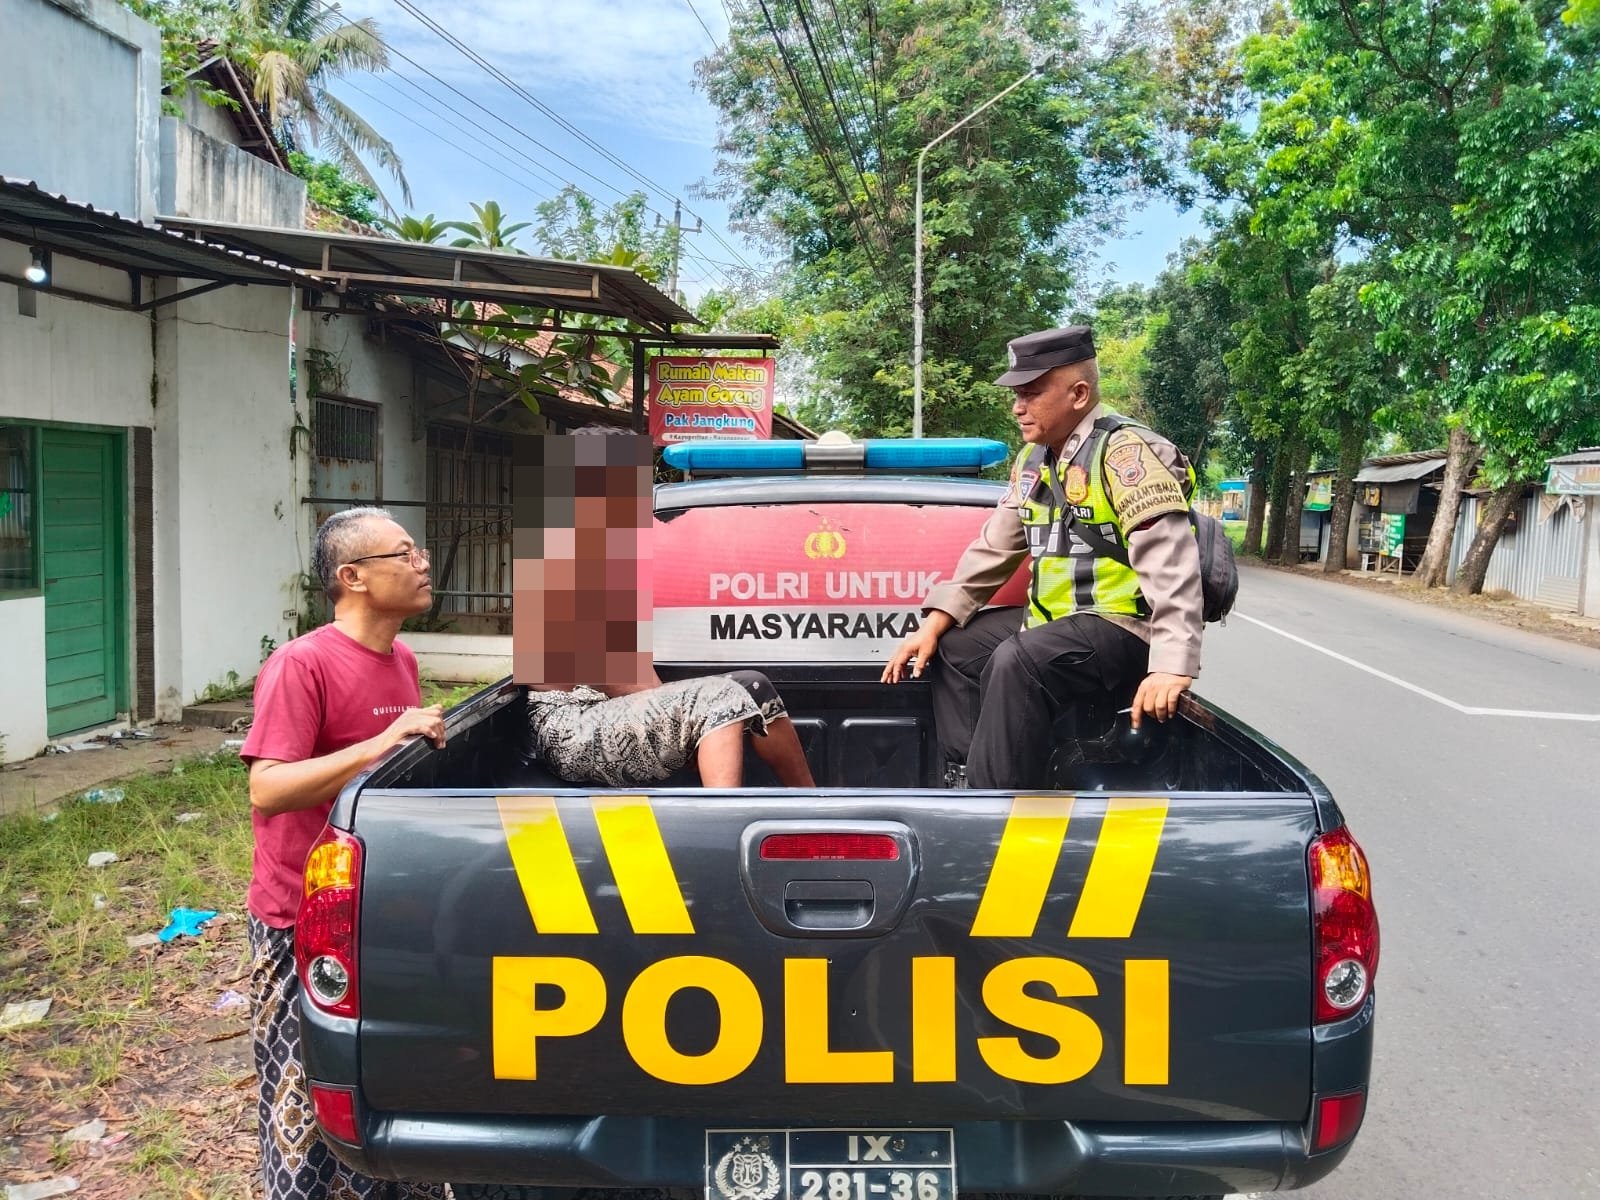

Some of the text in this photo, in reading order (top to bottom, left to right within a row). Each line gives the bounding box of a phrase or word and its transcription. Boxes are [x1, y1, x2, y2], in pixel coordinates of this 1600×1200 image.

[658, 362, 766, 383] Rumah Makan
[659, 384, 763, 411] Ayam Goreng
[665, 413, 756, 431] Pak Jangkung
[709, 571, 941, 600] POLRI UNTUK
[710, 612, 926, 640] MASYARAKA
[492, 955, 1169, 1085] POLISI
[848, 1135, 892, 1162] IX
[801, 1171, 939, 1200] 281-36
